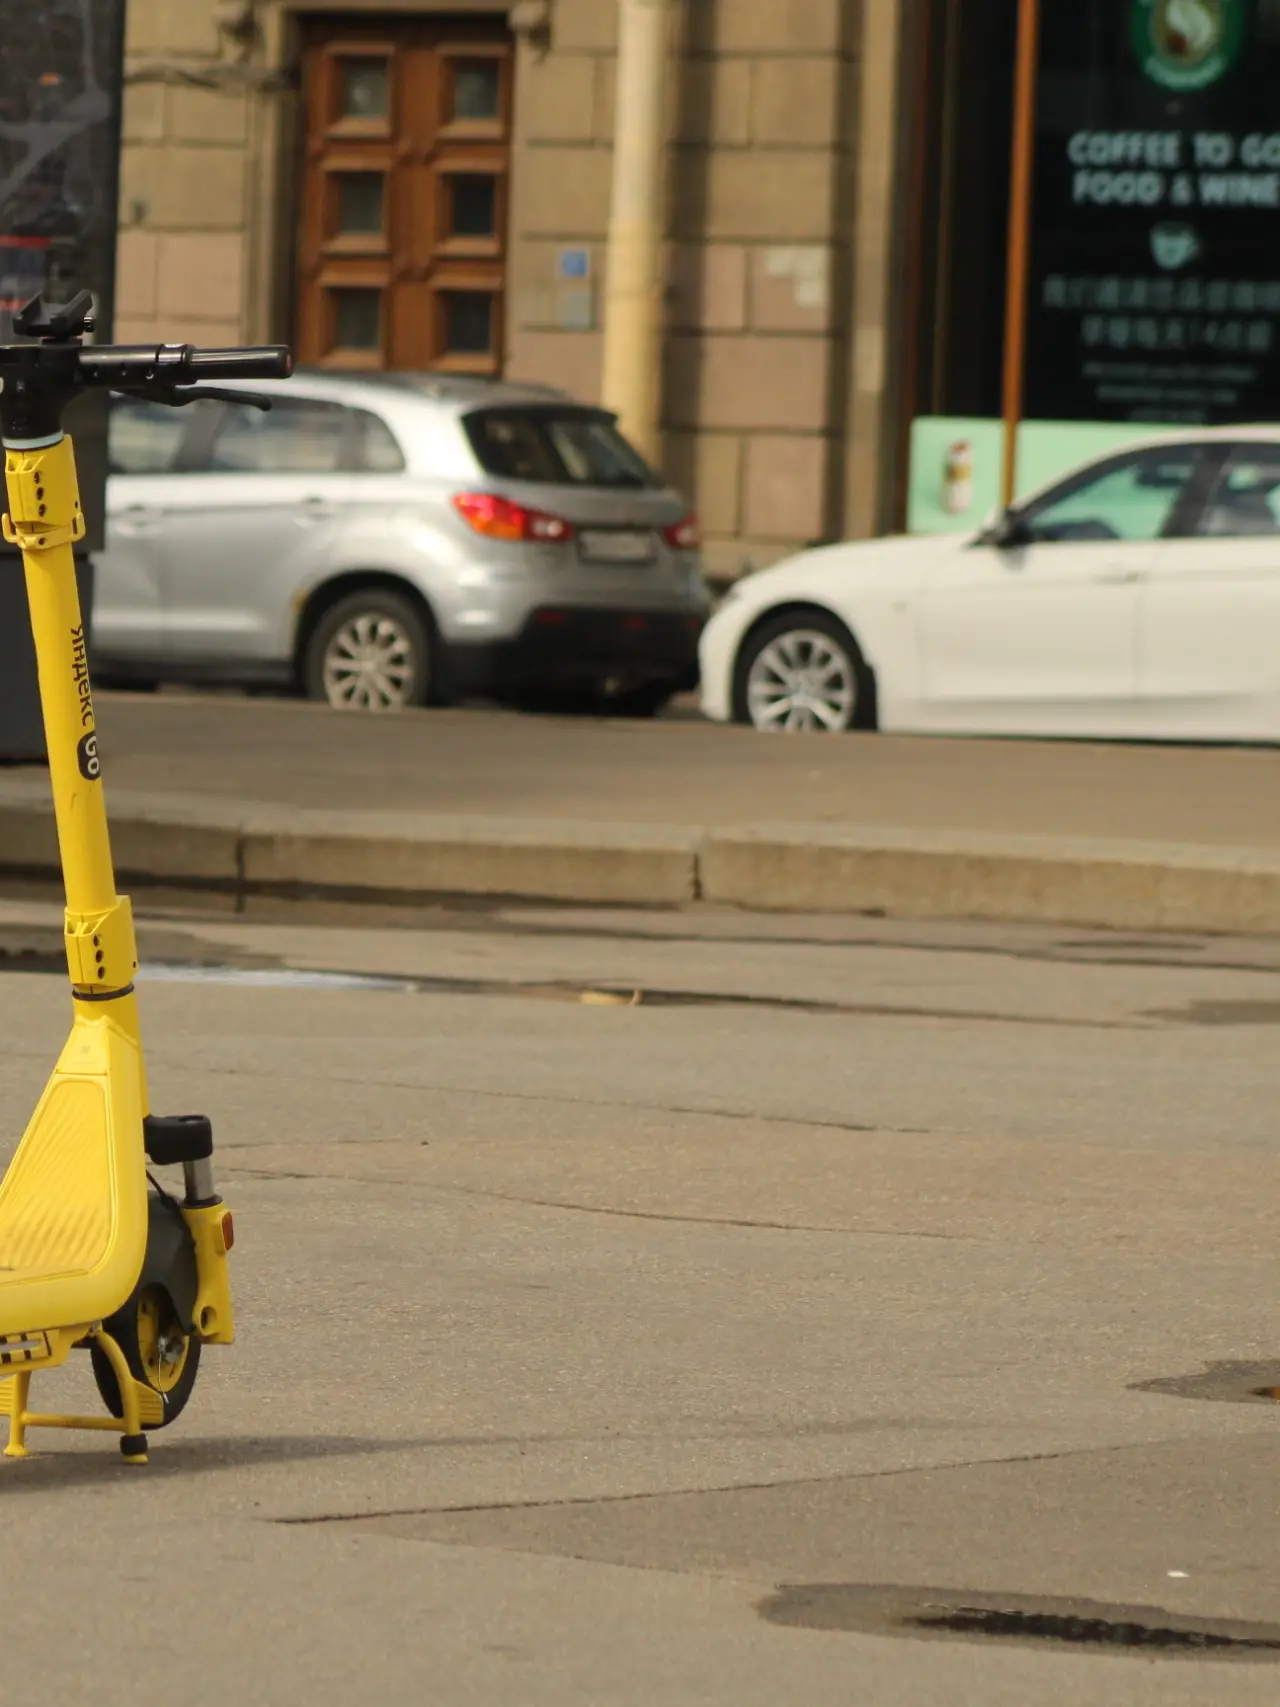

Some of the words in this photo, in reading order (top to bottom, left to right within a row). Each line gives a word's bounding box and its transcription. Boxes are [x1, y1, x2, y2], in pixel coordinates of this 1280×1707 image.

[1068, 131, 1181, 167] COFFEE
[1191, 131, 1233, 167] TO
[1073, 169, 1163, 206] FOOD
[1170, 173, 1192, 206] &
[1198, 172, 1279, 208] WINE
